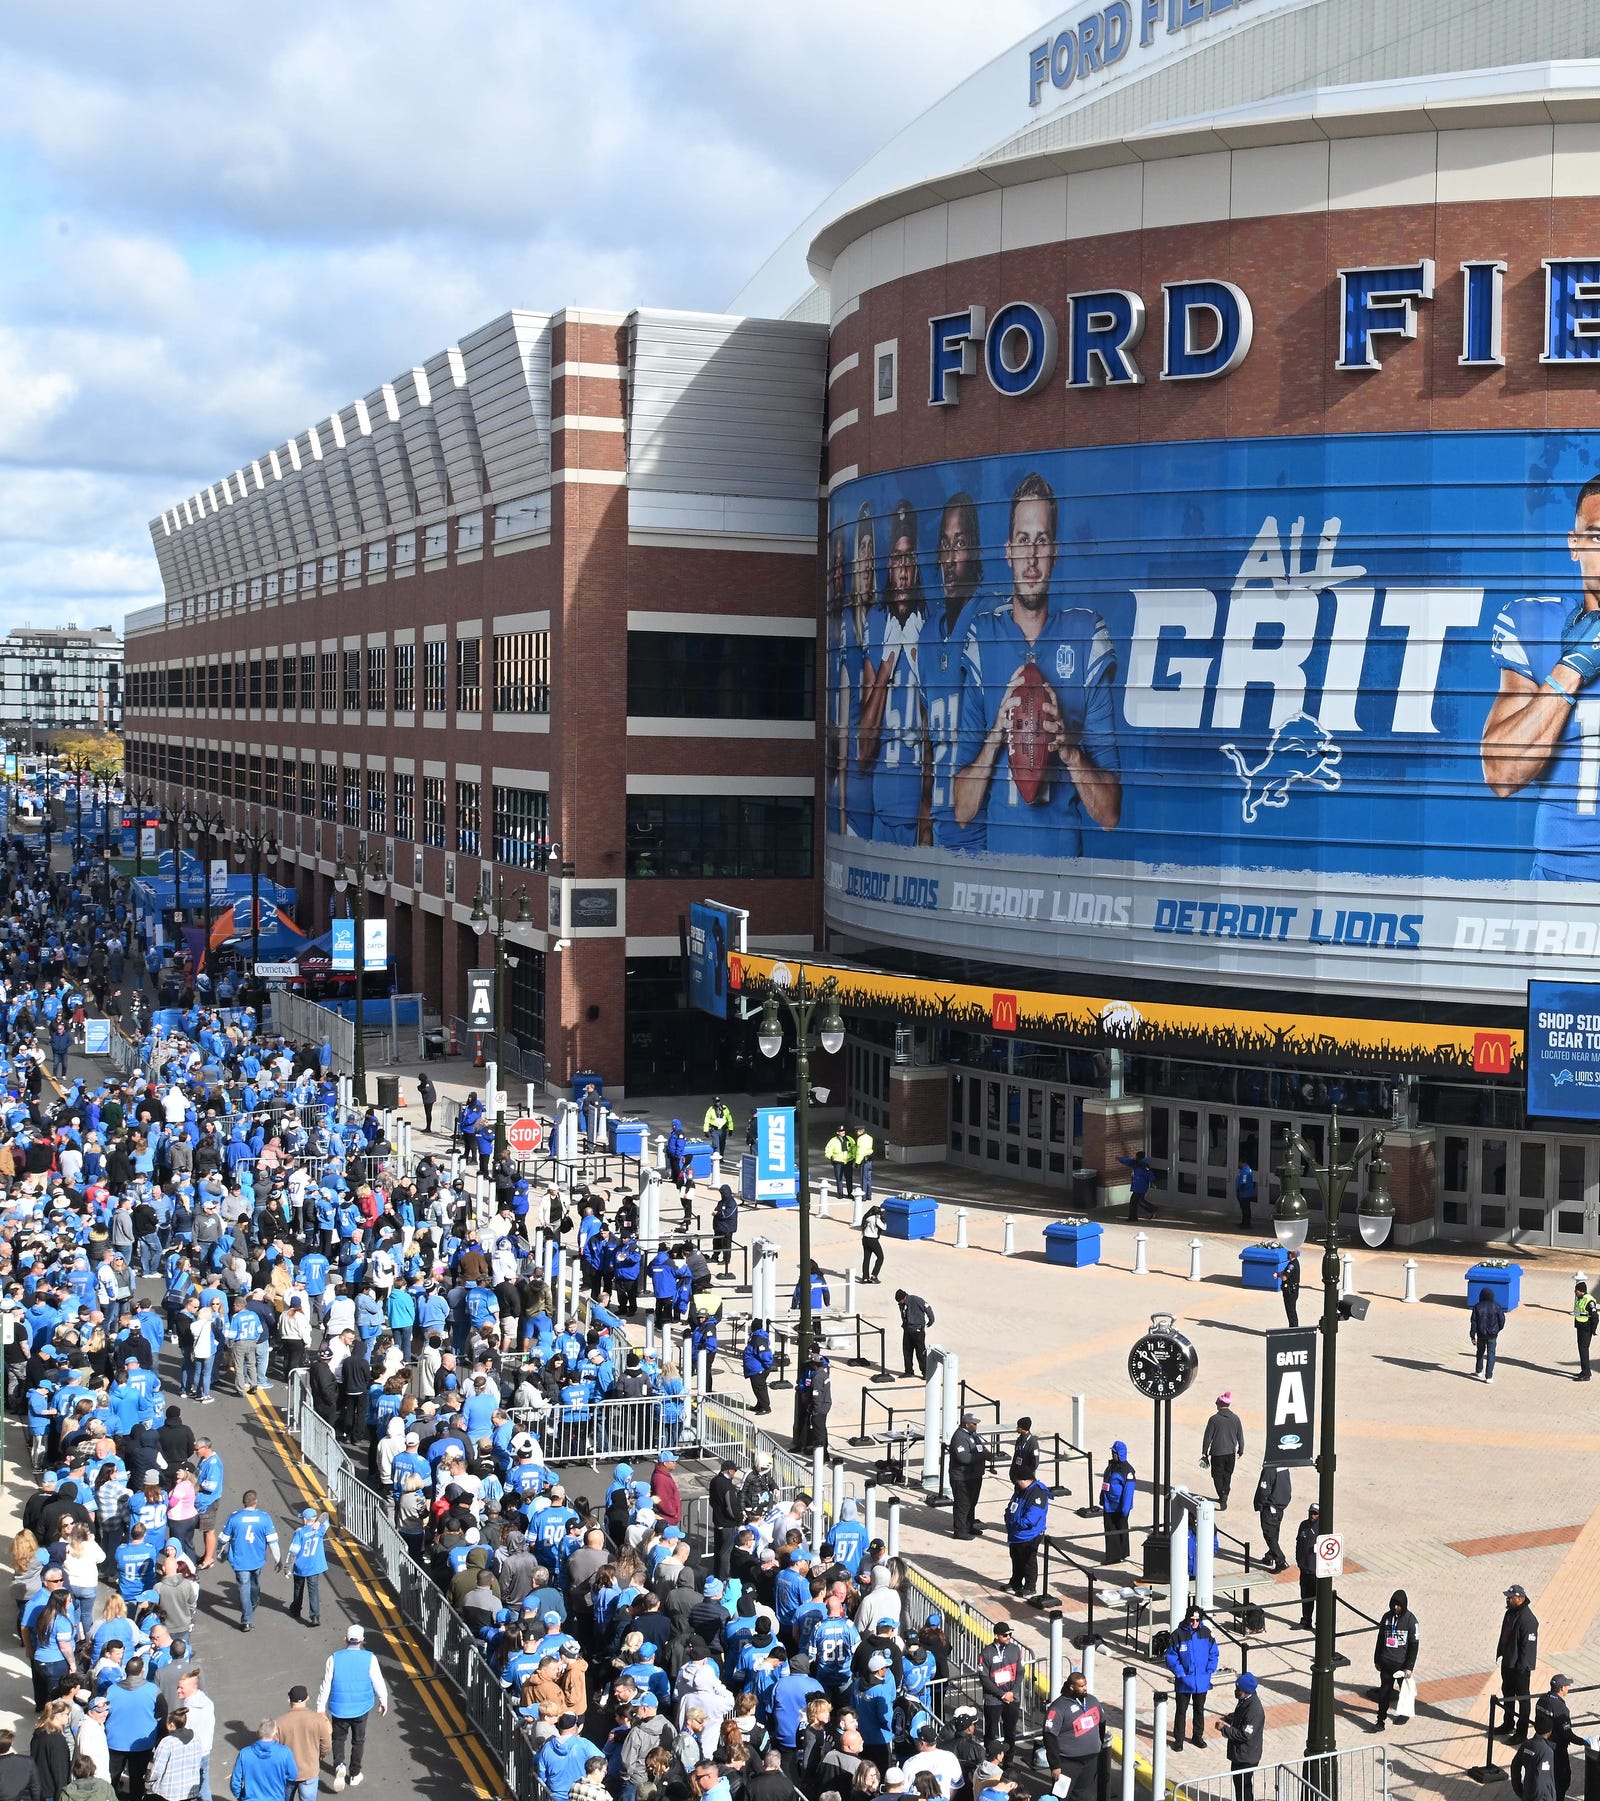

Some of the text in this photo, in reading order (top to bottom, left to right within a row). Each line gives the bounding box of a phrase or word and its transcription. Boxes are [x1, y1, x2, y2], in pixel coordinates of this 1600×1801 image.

[1028, 0, 1132, 107] FORD
[928, 279, 1252, 407] FORD
[1230, 515, 1367, 599] ALL
[1123, 587, 1484, 734] GRIT
[846, 866, 939, 910] DETROIT LIONS
[951, 882, 1133, 928] DETROIT LIONS
[1154, 899, 1424, 949] DETROIT LIONS
[473, 979, 490, 987] GATE
[472, 989, 491, 1014] A
[1538, 1012, 1573, 1031] SHOP
[1549, 1031, 1583, 1049] GEAR
[1541, 1050, 1569, 1061] LOCATED
[1571, 1051, 1589, 1062] NEAR
[1575, 1070, 1593, 1083] LIONS
[511, 1128, 540, 1142] STOP
[768, 1115, 786, 1172] LIONS
[240, 1322, 256, 1340] 54
[1277, 1351, 1308, 1366] GATE
[1274, 1371, 1308, 1426] A
[140, 1506, 166, 1529] 20
[245, 1524, 255, 1543] 4
[303, 1537, 318, 1557] 97
[837, 1541, 858, 1562] 97
[823, 1639, 845, 1662] 81
